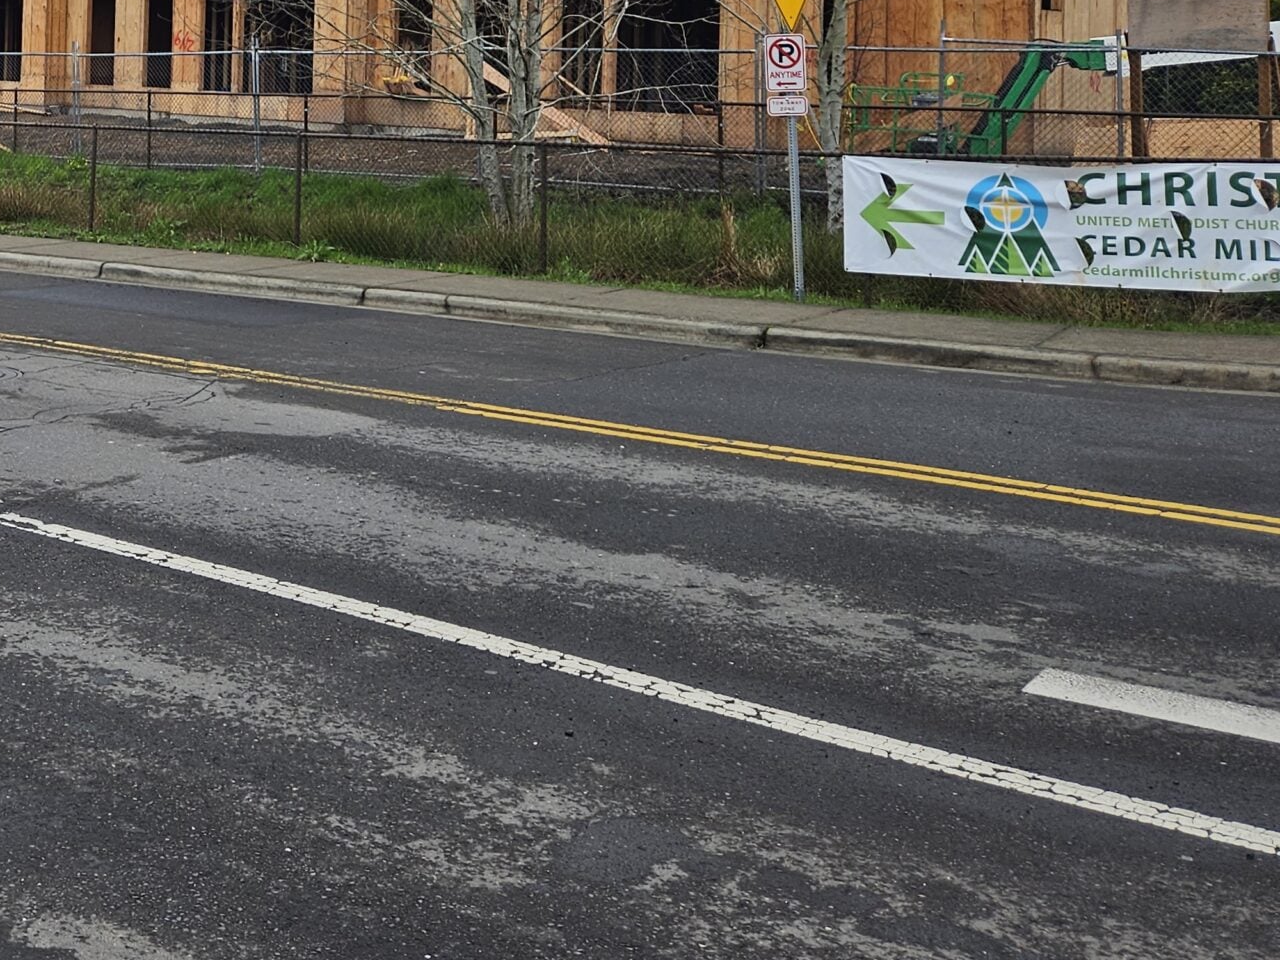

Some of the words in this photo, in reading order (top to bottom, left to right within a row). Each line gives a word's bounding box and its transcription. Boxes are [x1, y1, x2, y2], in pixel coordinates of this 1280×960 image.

[770, 70, 803, 79] ANYTIME
[1076, 215, 1132, 227] UNITED
[1138, 217, 1229, 229] METDIST
[1082, 264, 1280, 283] cedarmillchristumc.org
